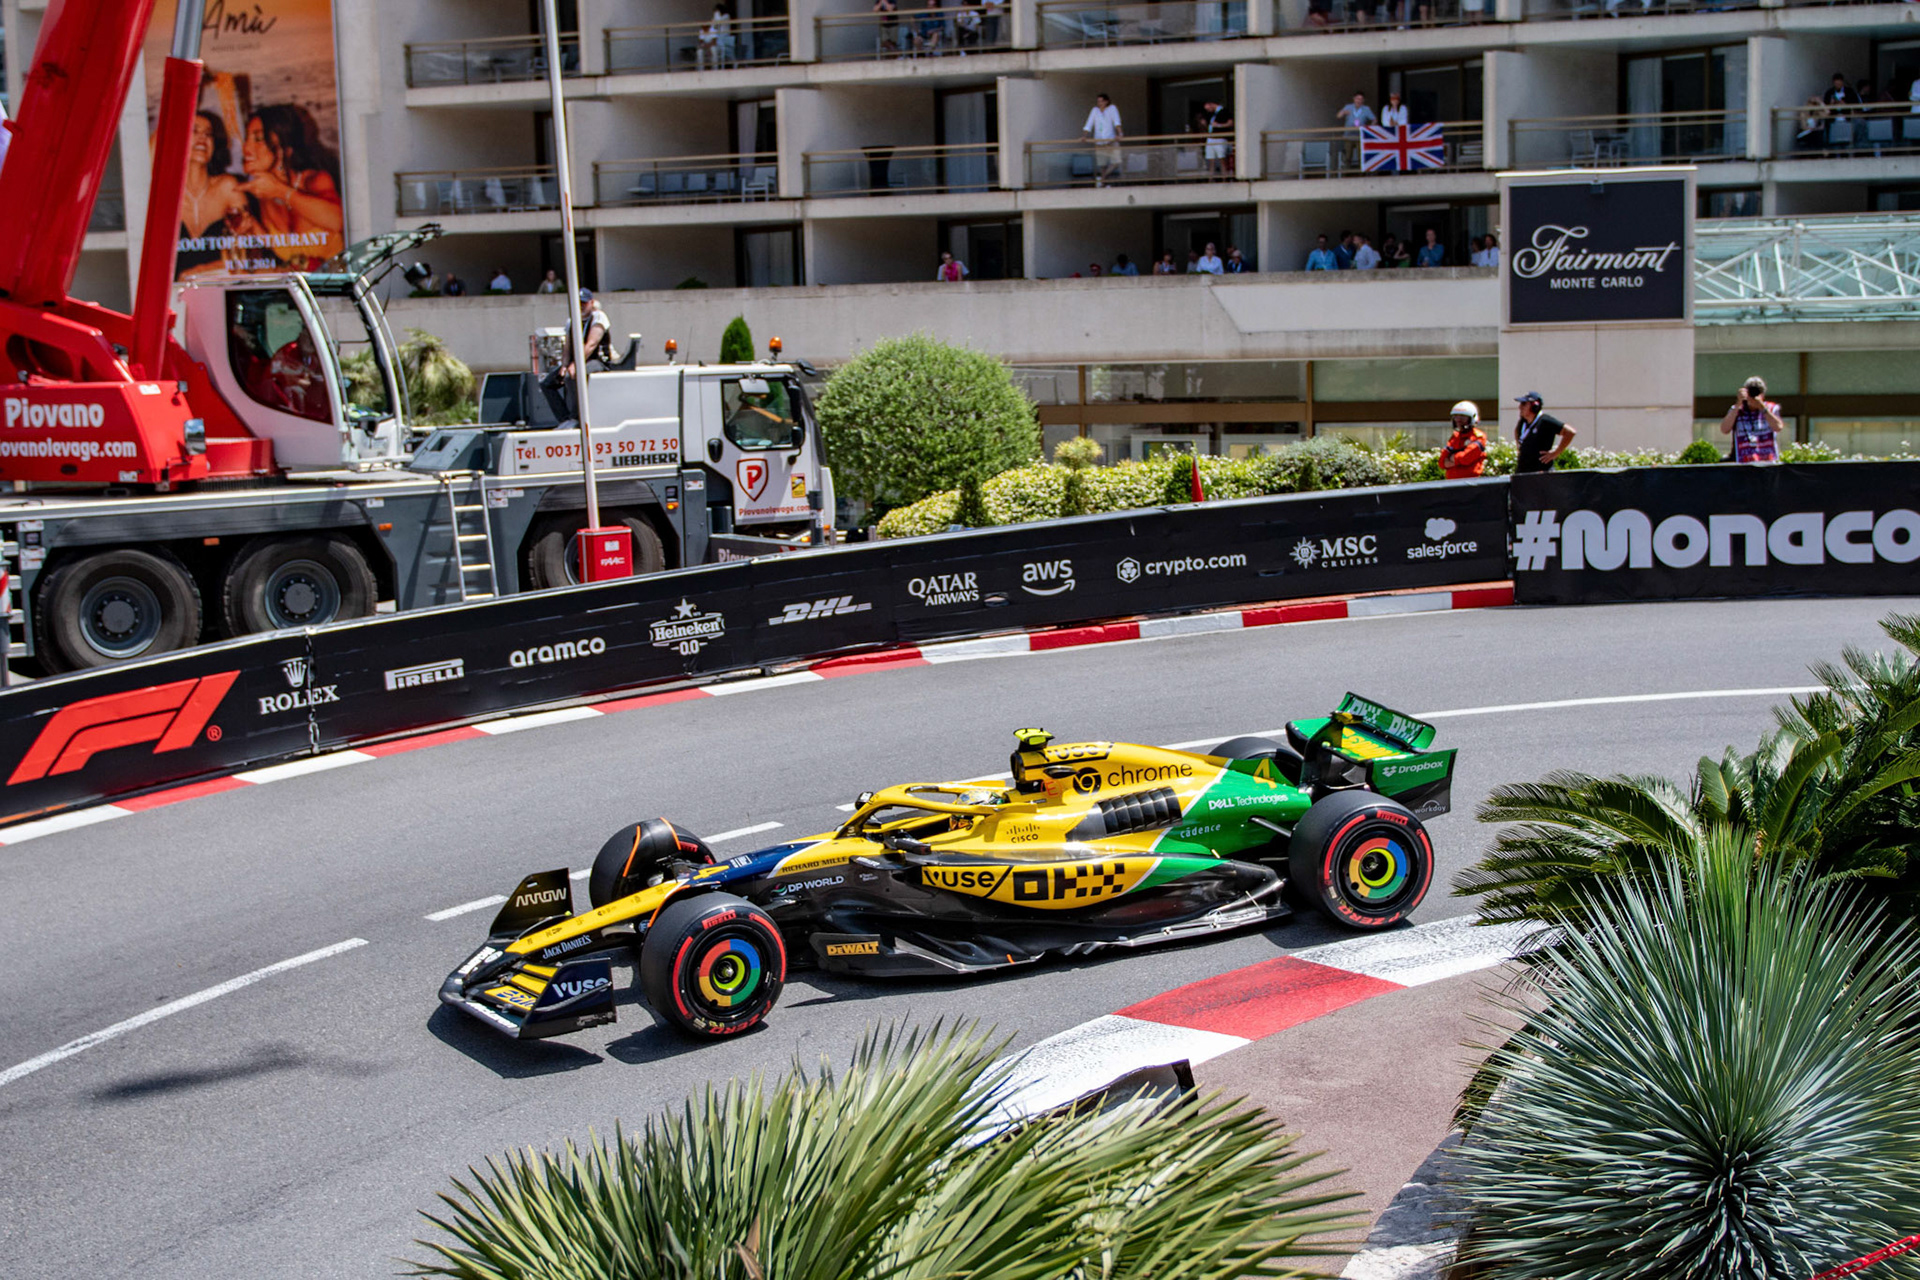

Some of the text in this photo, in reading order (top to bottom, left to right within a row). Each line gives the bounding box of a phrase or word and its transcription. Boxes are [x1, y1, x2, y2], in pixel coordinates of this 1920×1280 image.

[237, 232, 330, 249] RESTAURANT
[1512, 225, 1681, 279] Fairmont
[1550, 276, 1644, 289] MONTE CARLO
[5, 397, 104, 428] Piovano
[0, 437, 137, 461] ovanolevage.com
[516, 445, 541, 460] Tél.
[595, 441, 612, 455] 93
[618, 440, 635, 454] 50
[640, 439, 656, 452] 72
[662, 437, 678, 450] 50
[612, 452, 678, 467] LIEBHERR
[1320, 534, 1378, 558] MSC
[1406, 540, 1478, 561] salesforce
[1022, 560, 1074, 583] aws
[1145, 553, 1247, 576] crypto.com
[1321, 556, 1379, 568] CRUISES
[907, 571, 979, 599] QATAR
[781, 595, 855, 623] DHL
[924, 589, 980, 607] AIRWAYS
[653, 617, 722, 642] Heineken
[509, 637, 606, 668] aramco
[384, 657, 465, 691] PIRELLI
[259, 684, 341, 715] ROLEX
[1107, 762, 1193, 787] chrome
[1398, 760, 1444, 775] Dropbox
[1208, 793, 1289, 810] DELL Technologies
[782, 861, 820, 874] RICHARD
[821, 856, 849, 867] MILLE
[788, 875, 845, 893] DP WORLD
[542, 935, 593, 960] JACK DANIEL'S
